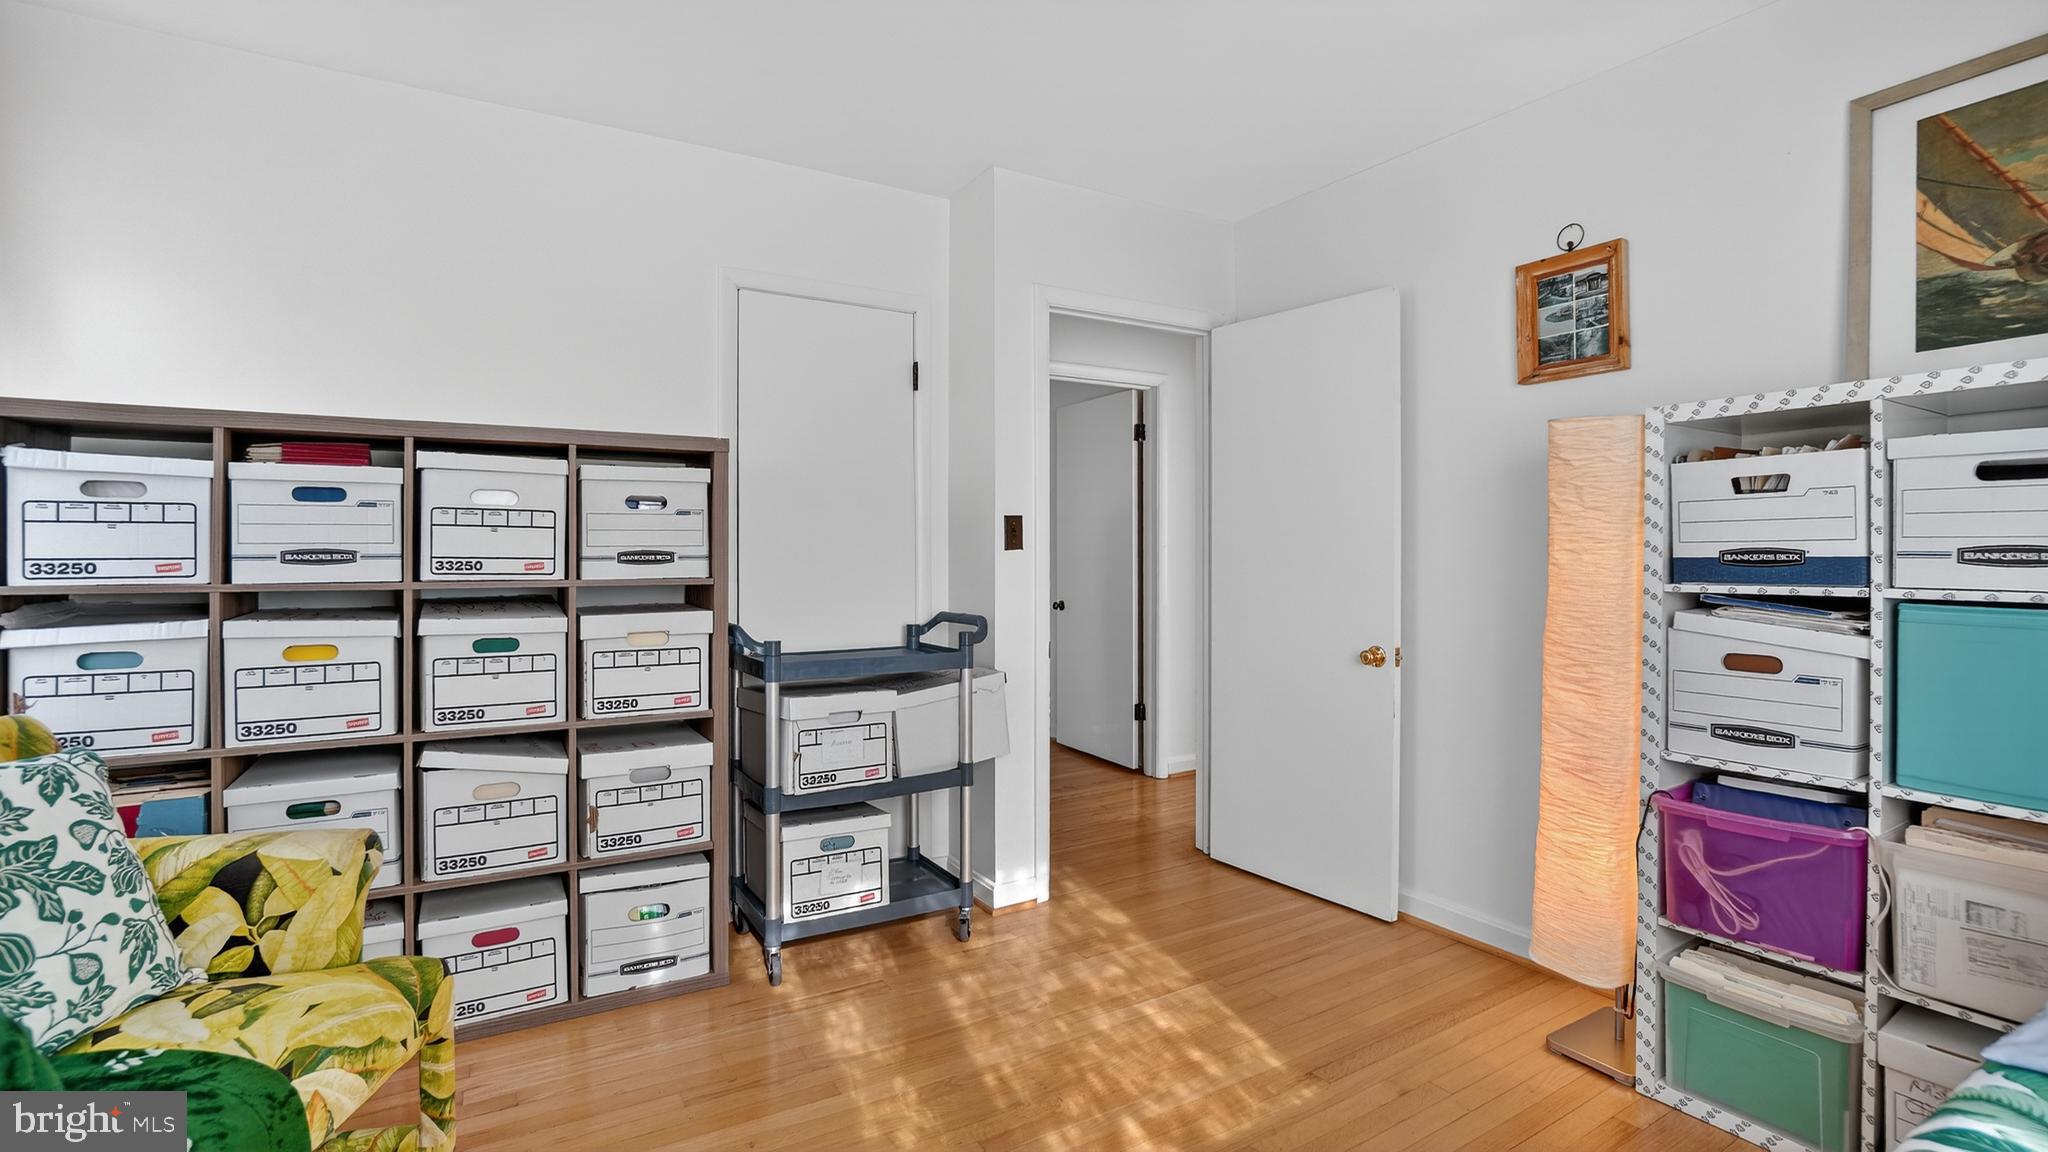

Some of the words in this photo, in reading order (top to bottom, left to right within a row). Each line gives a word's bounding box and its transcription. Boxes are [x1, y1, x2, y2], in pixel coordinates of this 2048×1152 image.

[285, 553, 332, 561] BANKERS
[1723, 553, 1775, 561] BANKERS
[1776, 553, 1801, 561] BOX
[1963, 552, 2039, 560] BANKERS
[29, 562, 97, 575] 33250
[435, 560, 483, 571] 33250
[596, 698, 638, 711] 33250
[436, 708, 485, 722] 33250
[240, 722, 297, 738] 33250
[1715, 728, 1765, 741] BANKERS
[1766, 734, 1791, 744] BOX
[57, 735, 94, 748] 250
[600, 834, 642, 849] 33250
[438, 855, 487, 871] 33250
[456, 1001, 486, 1017] 250
